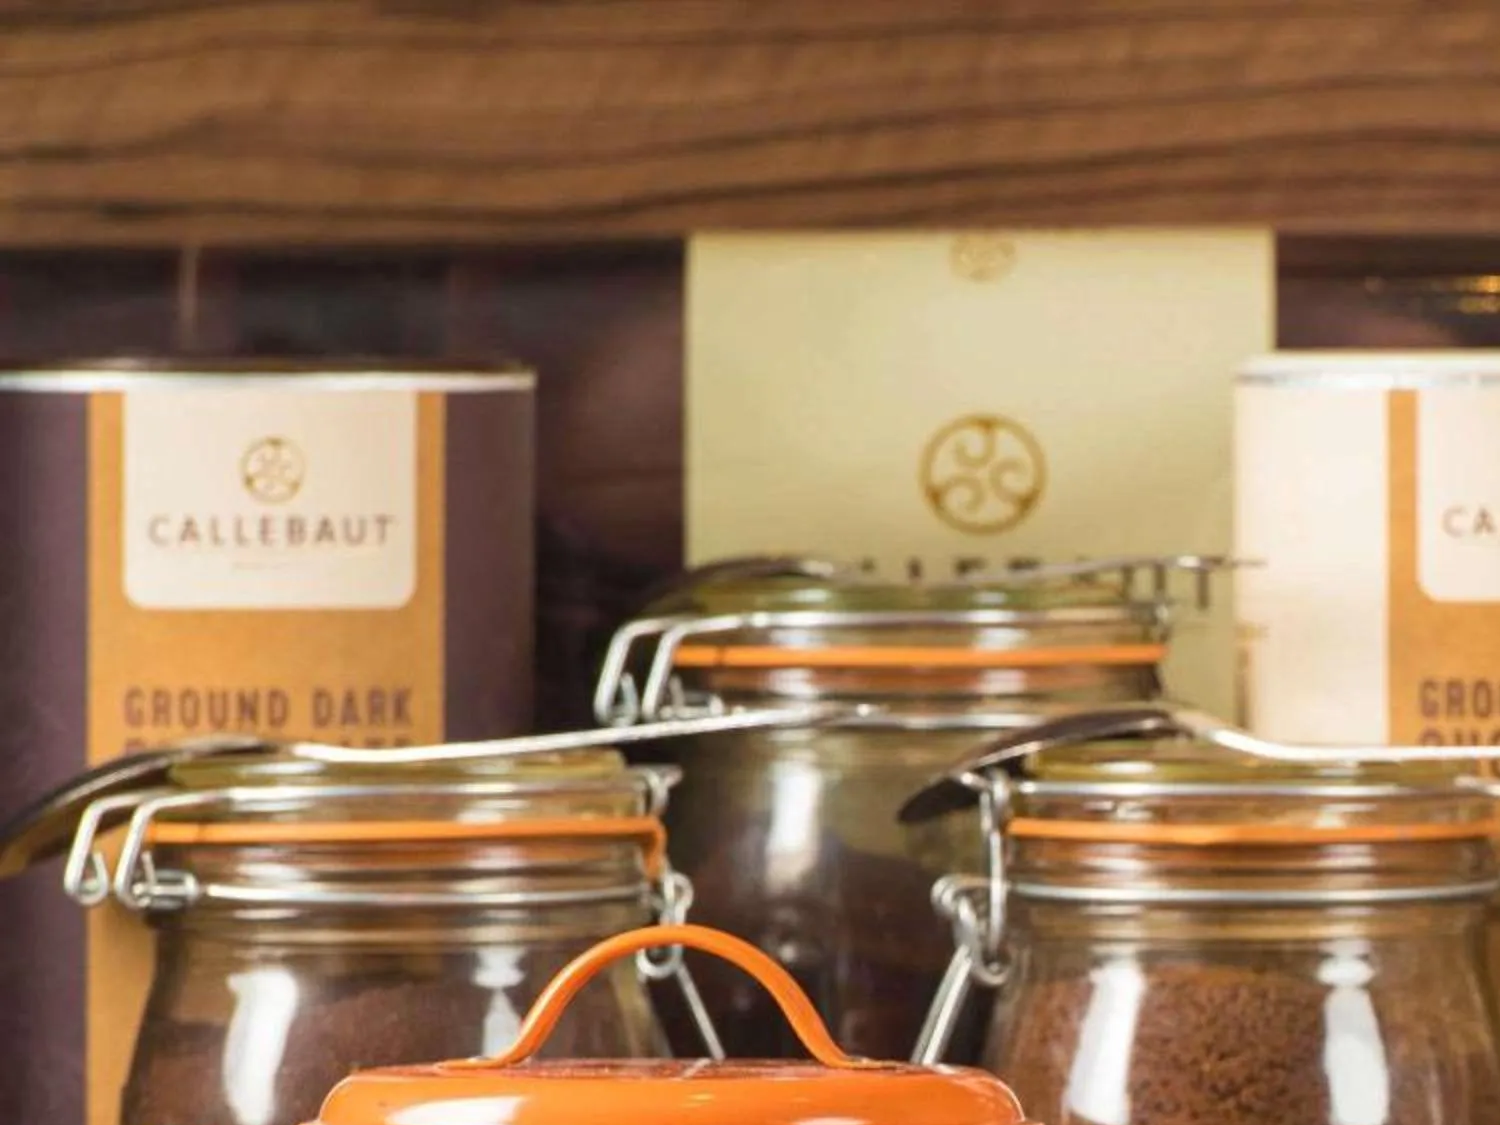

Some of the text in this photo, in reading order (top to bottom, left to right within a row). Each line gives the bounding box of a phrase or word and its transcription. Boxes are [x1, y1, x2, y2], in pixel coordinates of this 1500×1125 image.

[148, 513, 395, 547] CALLEBAUT
[124, 687, 411, 728] GROUND DARK
